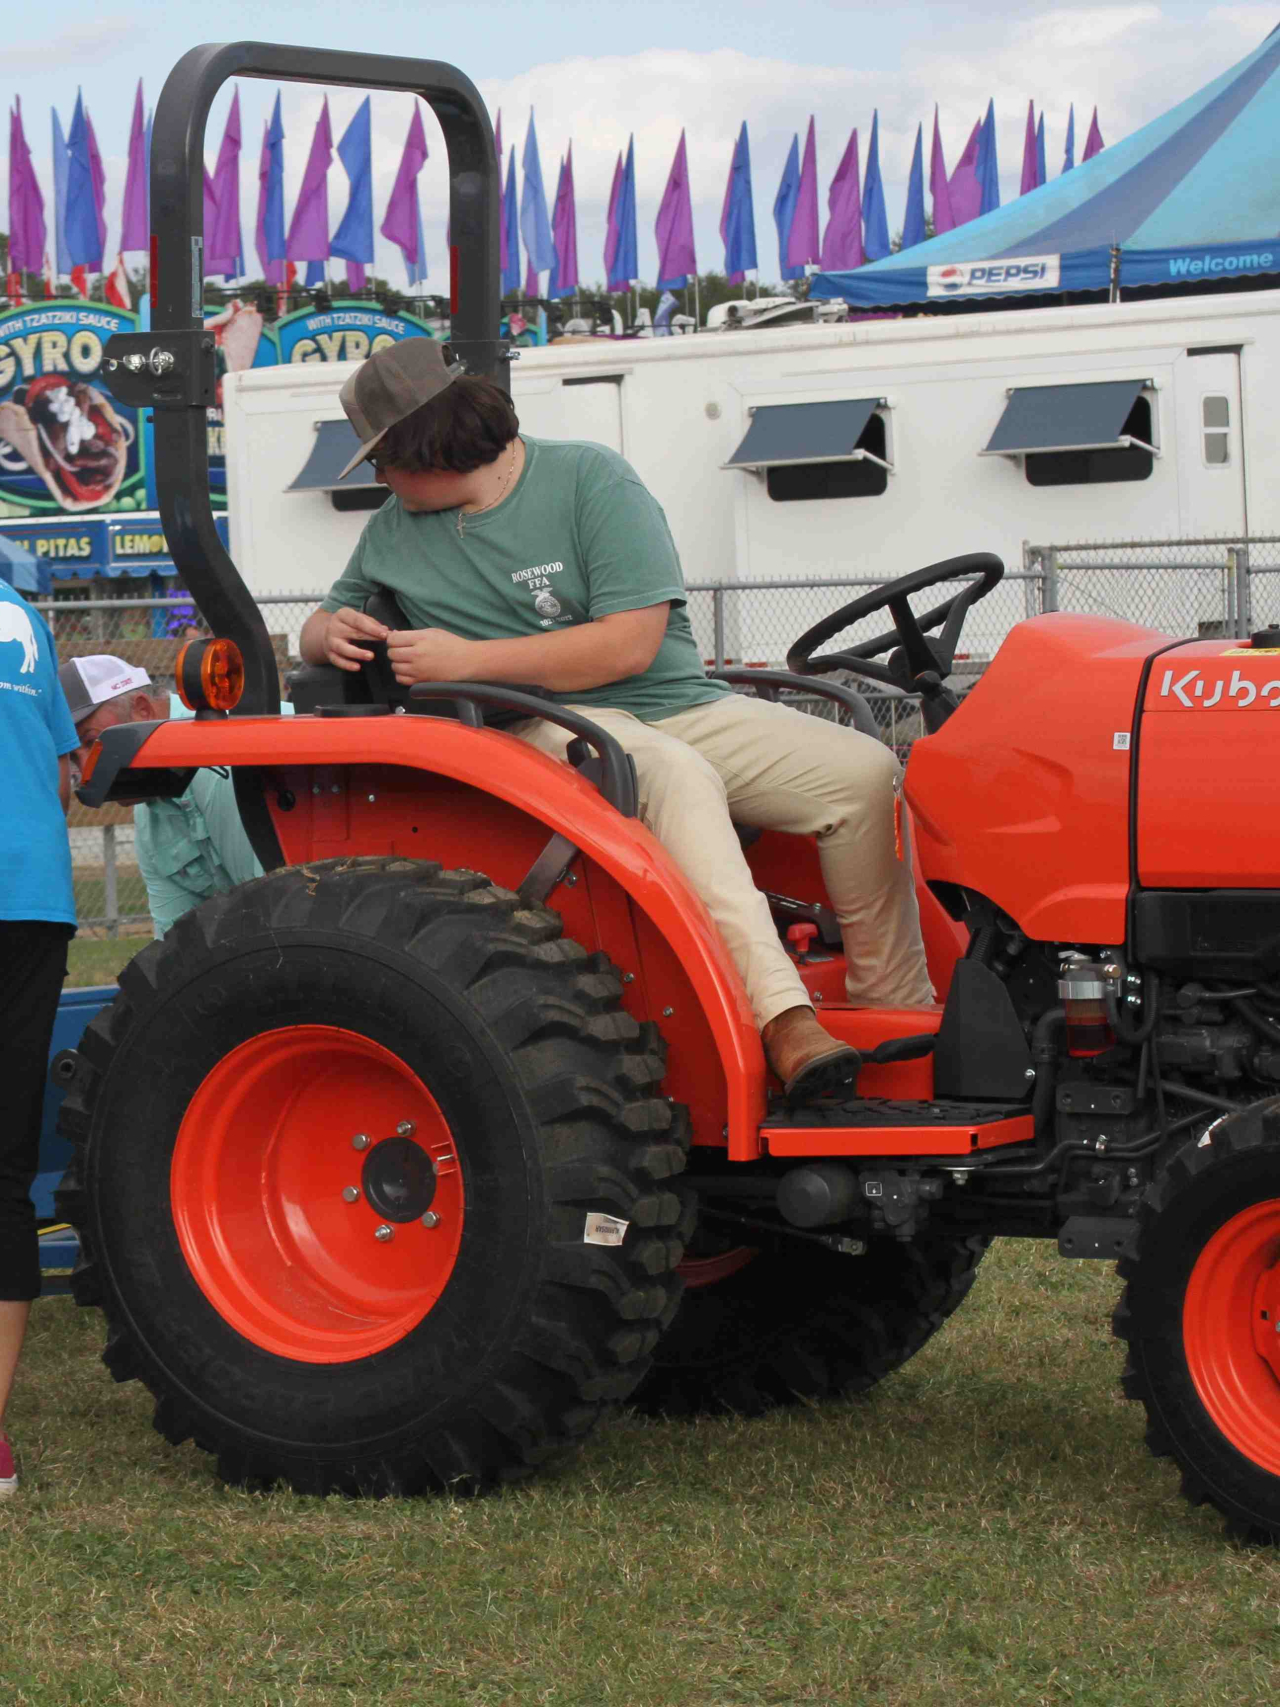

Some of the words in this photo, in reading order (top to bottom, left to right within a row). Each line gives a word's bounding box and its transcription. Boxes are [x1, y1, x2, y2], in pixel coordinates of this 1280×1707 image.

[967, 262, 1046, 285] PEPSI
[1169, 252, 1274, 276] Welcome
[24, 311, 77, 327] TZATZIKI
[78, 312, 119, 331] SAUCE
[307, 314, 332, 331] WITH
[332, 312, 374, 326] TZATZIKI
[374, 315, 405, 334] SAUCE
[36, 537, 91, 558] PITAS
[511, 561, 564, 583] ROSEWOOD
[527, 576, 550, 589] FFA
